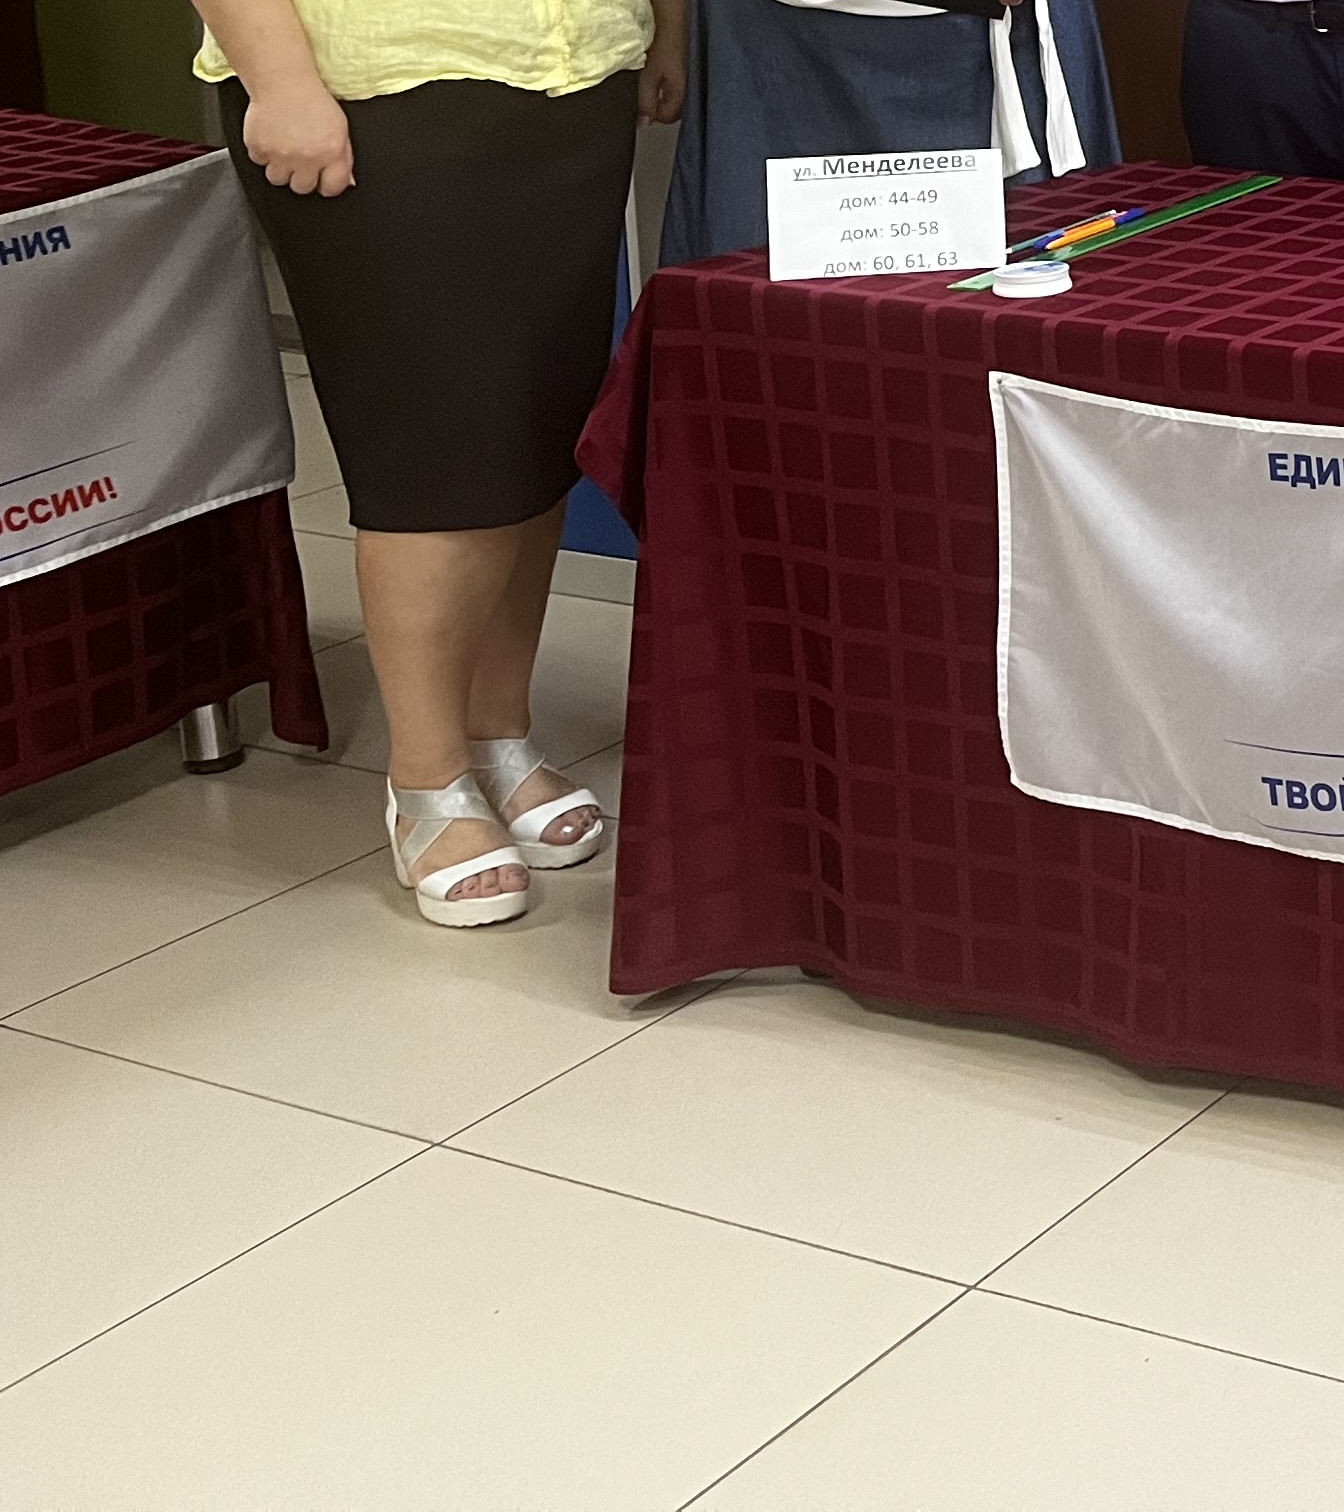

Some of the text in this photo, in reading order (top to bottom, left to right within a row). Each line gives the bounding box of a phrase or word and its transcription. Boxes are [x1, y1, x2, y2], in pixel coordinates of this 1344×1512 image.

[793, 155, 976, 180] ул. Менделеева
[839, 189, 938, 210] дом: 44-49
[840, 221, 939, 243] дом: 50-58
[823, 252, 958, 277] дом: 60, 61, 63
[0, 476, 117, 535] ССИИ!
